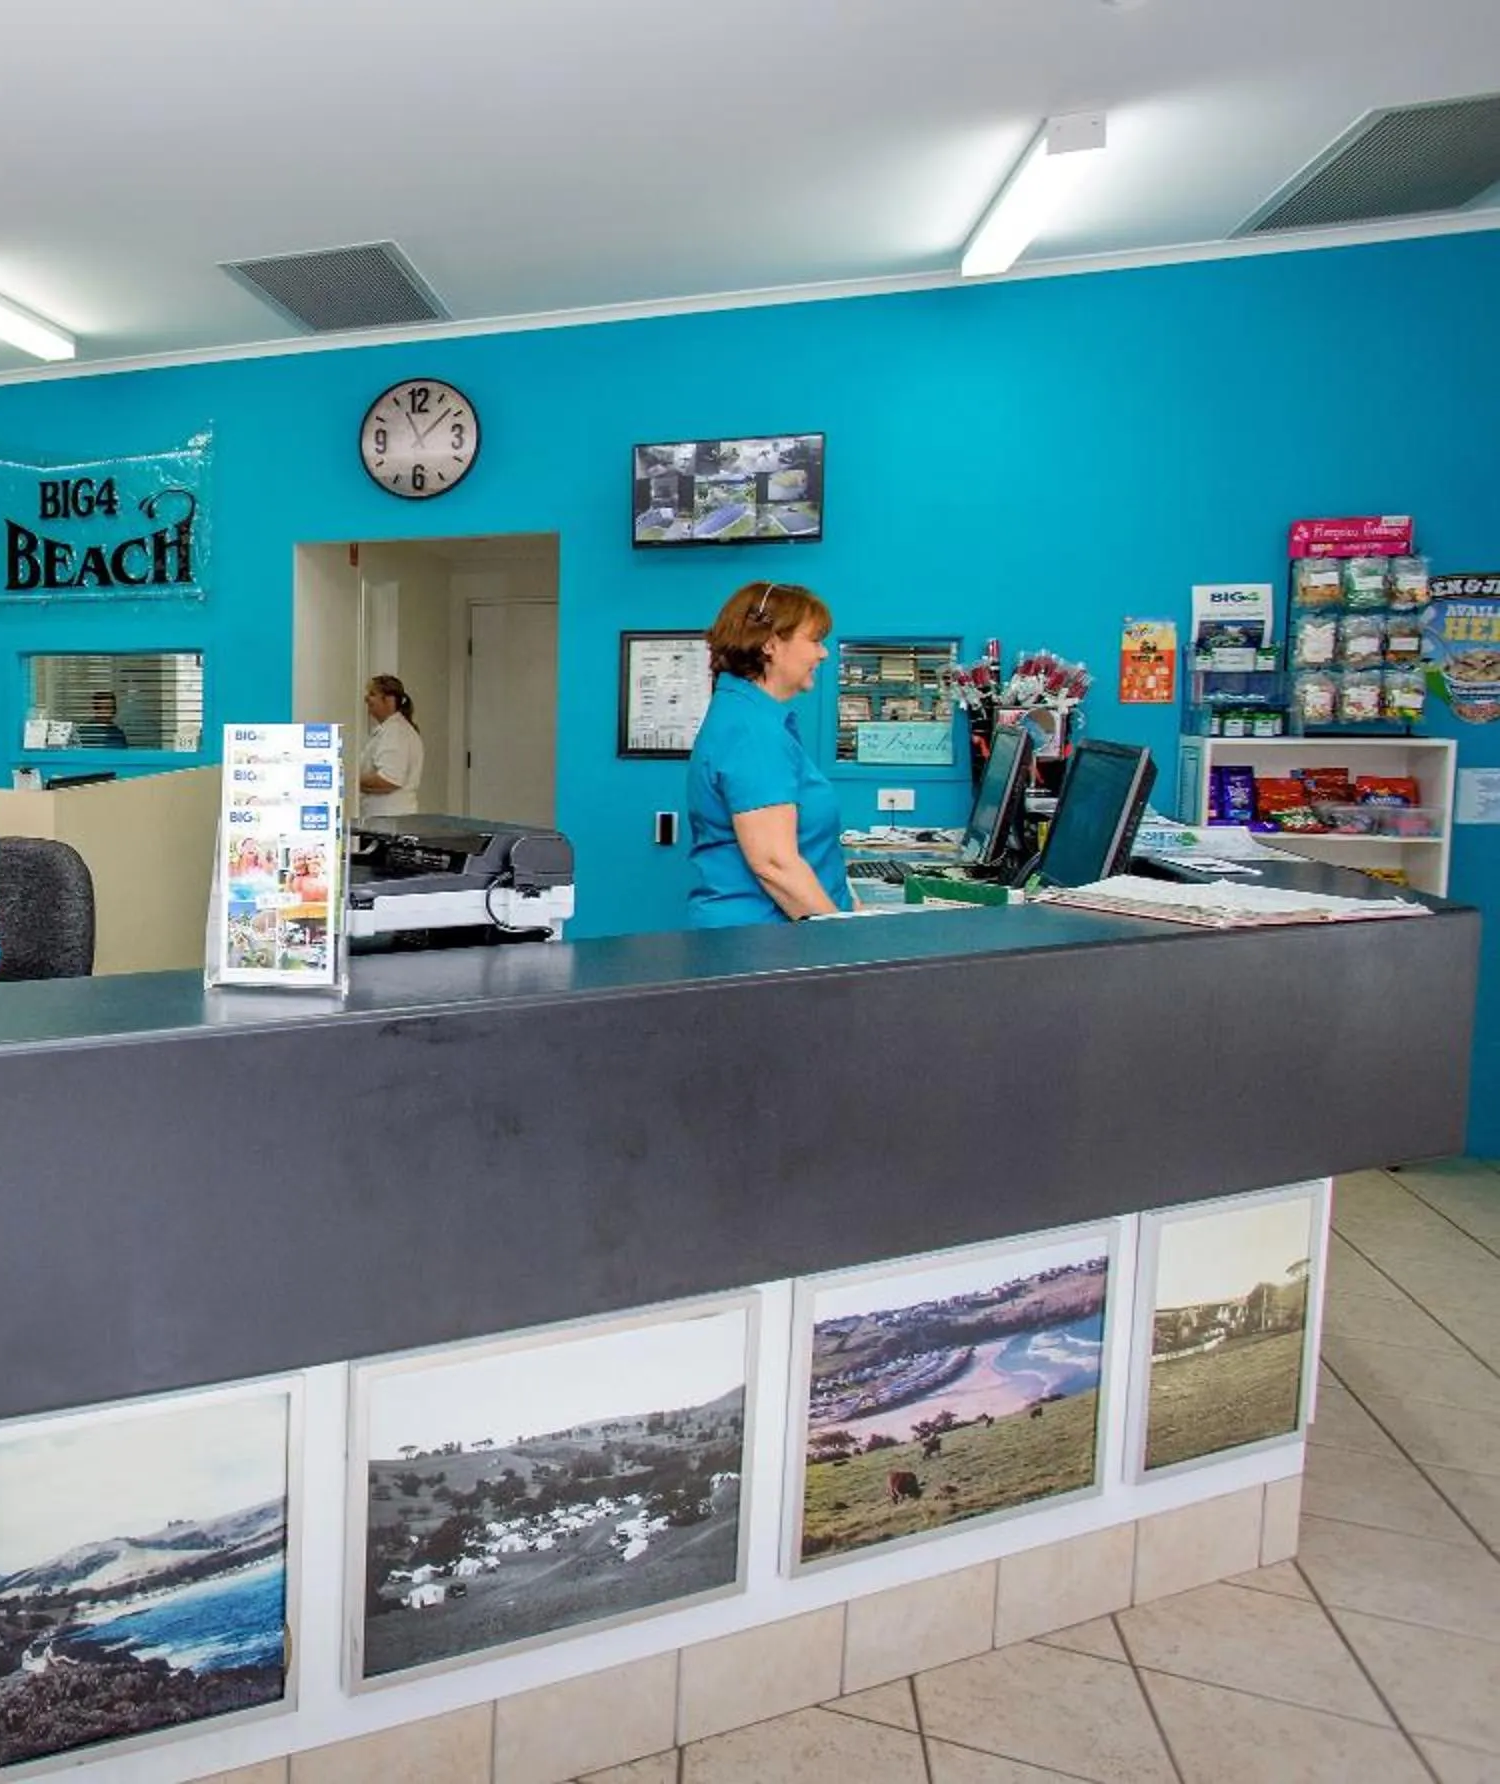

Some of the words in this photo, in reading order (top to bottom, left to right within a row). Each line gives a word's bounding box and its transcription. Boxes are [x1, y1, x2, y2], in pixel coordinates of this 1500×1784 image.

[408, 387, 429, 413] 12
[375, 428, 387, 454] 9
[451, 423, 464, 450] 3
[412, 463, 425, 490] 6
[39, 477, 119, 519] BIG4
[5, 490, 197, 591] BEACH
